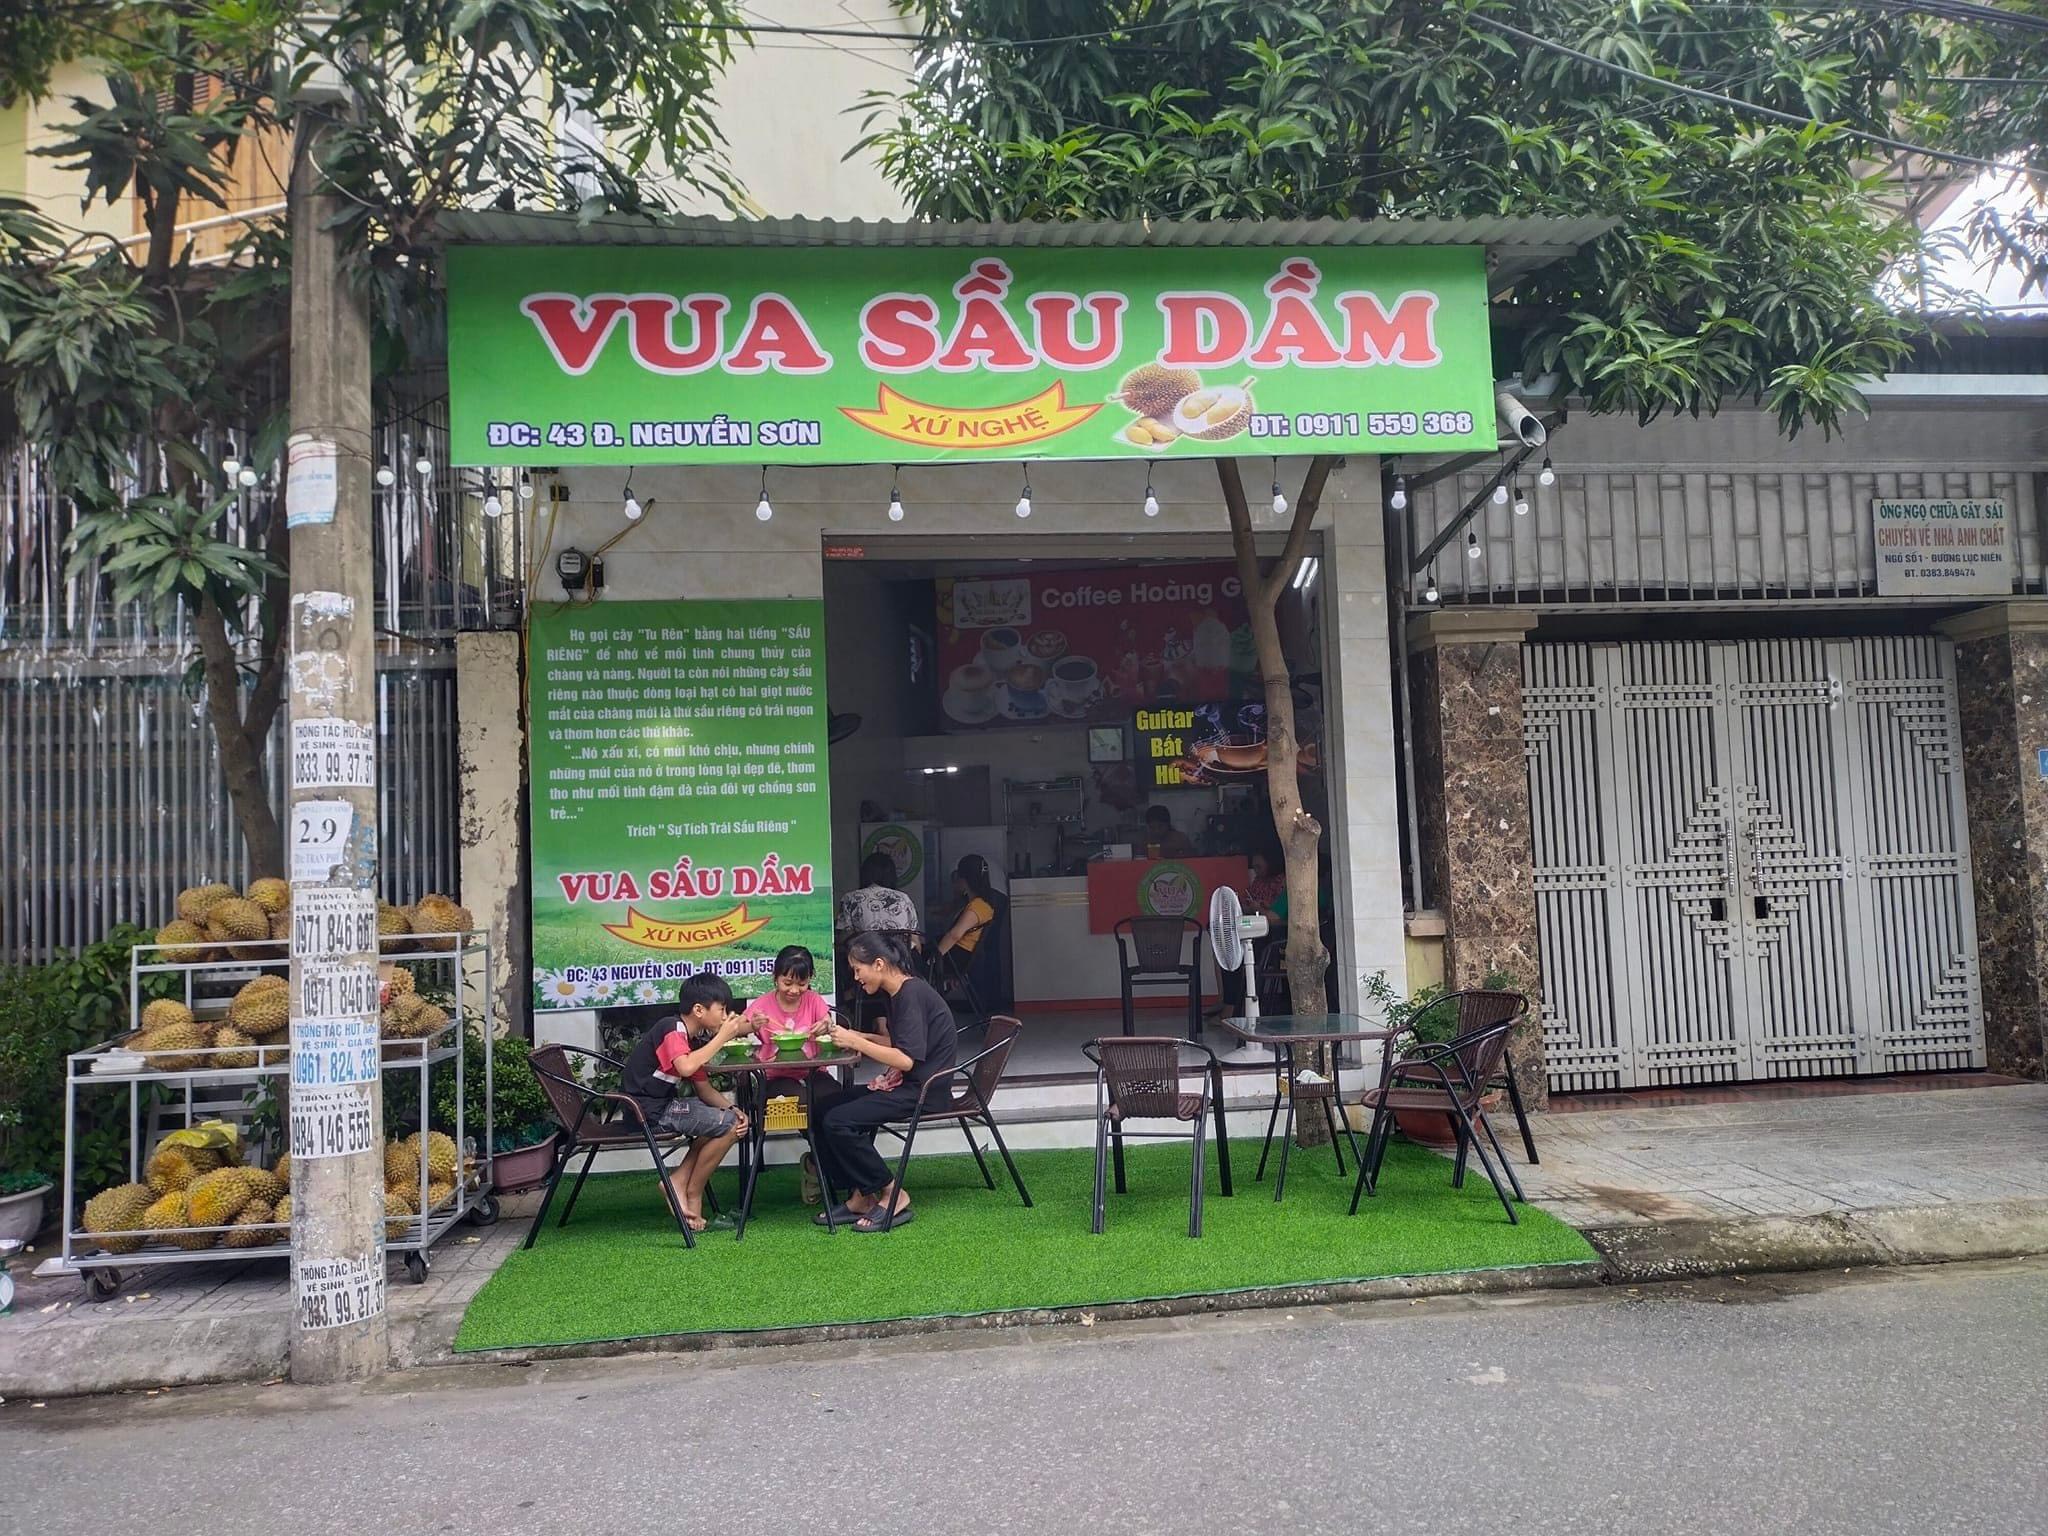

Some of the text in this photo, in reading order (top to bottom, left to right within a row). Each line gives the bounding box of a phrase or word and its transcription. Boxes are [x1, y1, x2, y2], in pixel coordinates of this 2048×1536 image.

[521, 257, 1442, 375] VUA SẦU DẦM
[488, 413, 820, 447] ĐC: 43 Đ. NGUYỄN SƠN
[901, 407, 1048, 437] XỨ NGHỆ
[1248, 410, 1473, 437] ĐT: 0911 559 368
[1930, 501, 1959, 519] CHỮA
[1958, 527, 1977, 546] ANH
[1041, 580, 1213, 609] Coffee Hoàng
[570, 628, 585, 643] Họ
[727, 628, 744, 639] hai
[721, 647, 755, 659] chung
[675, 668, 685, 678] ta
[787, 705, 813, 716] ngon
[1136, 709, 1194, 731] Guitar
[313, 741, 336, 749] SINH
[746, 743, 780, 756] nhưng
[1151, 734, 1183, 757] Bất
[665, 765, 695, 778] trong
[299, 818, 337, 843] 2.9
[627, 824, 656, 838] Trích
[559, 853, 812, 903] VUA SẦU DẦM
[296, 915, 320, 953] 0971
[328, 913, 352, 952] 846
[642, 921, 736, 942] XỨ NGHỆ
[567, 968, 588, 982] ĐC:
[592, 967, 608, 981] 43
[611, 961, 662, 980] NGUYỄN
[666, 962, 692, 977] SƠN
[726, 960, 754, 975] 0911
[304, 975, 362, 1016] 0971 846
[314, 1040, 337, 1049] SINH
[331, 1051, 356, 1082] 824.
[361, 1048, 377, 1080] 333
[319, 1109, 370, 1154] 146 556
[321, 1280, 344, 1291] SINH
[335, 1291, 354, 1323] 99.
